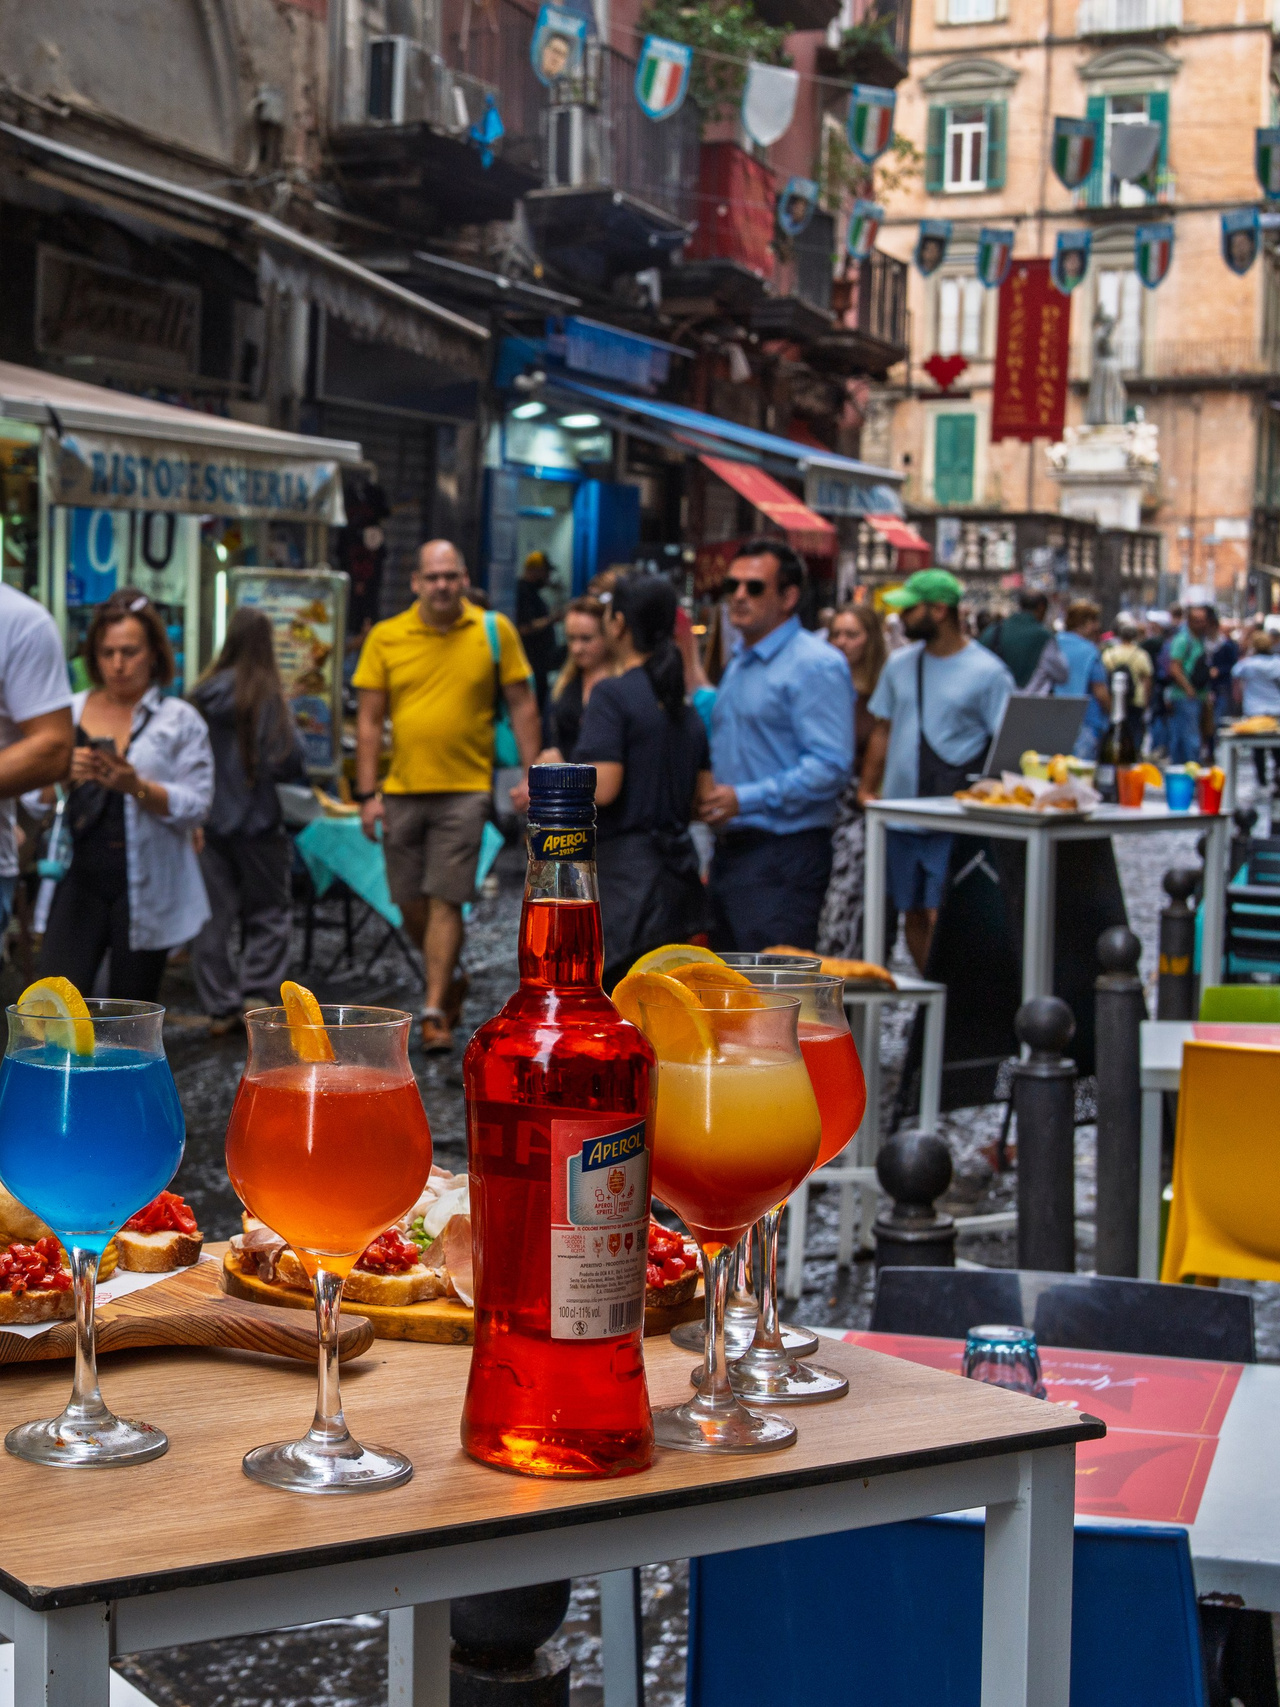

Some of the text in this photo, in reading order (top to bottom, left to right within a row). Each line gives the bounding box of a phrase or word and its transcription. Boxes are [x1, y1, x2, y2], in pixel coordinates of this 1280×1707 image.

[91, 451, 309, 509] RISTOPESCHERIA
[542, 831, 588, 852] APEROL
[559, 847, 575, 856] 1919
[588, 1132, 642, 1166] APEROL
[559, 1306, 569, 1318] 100
